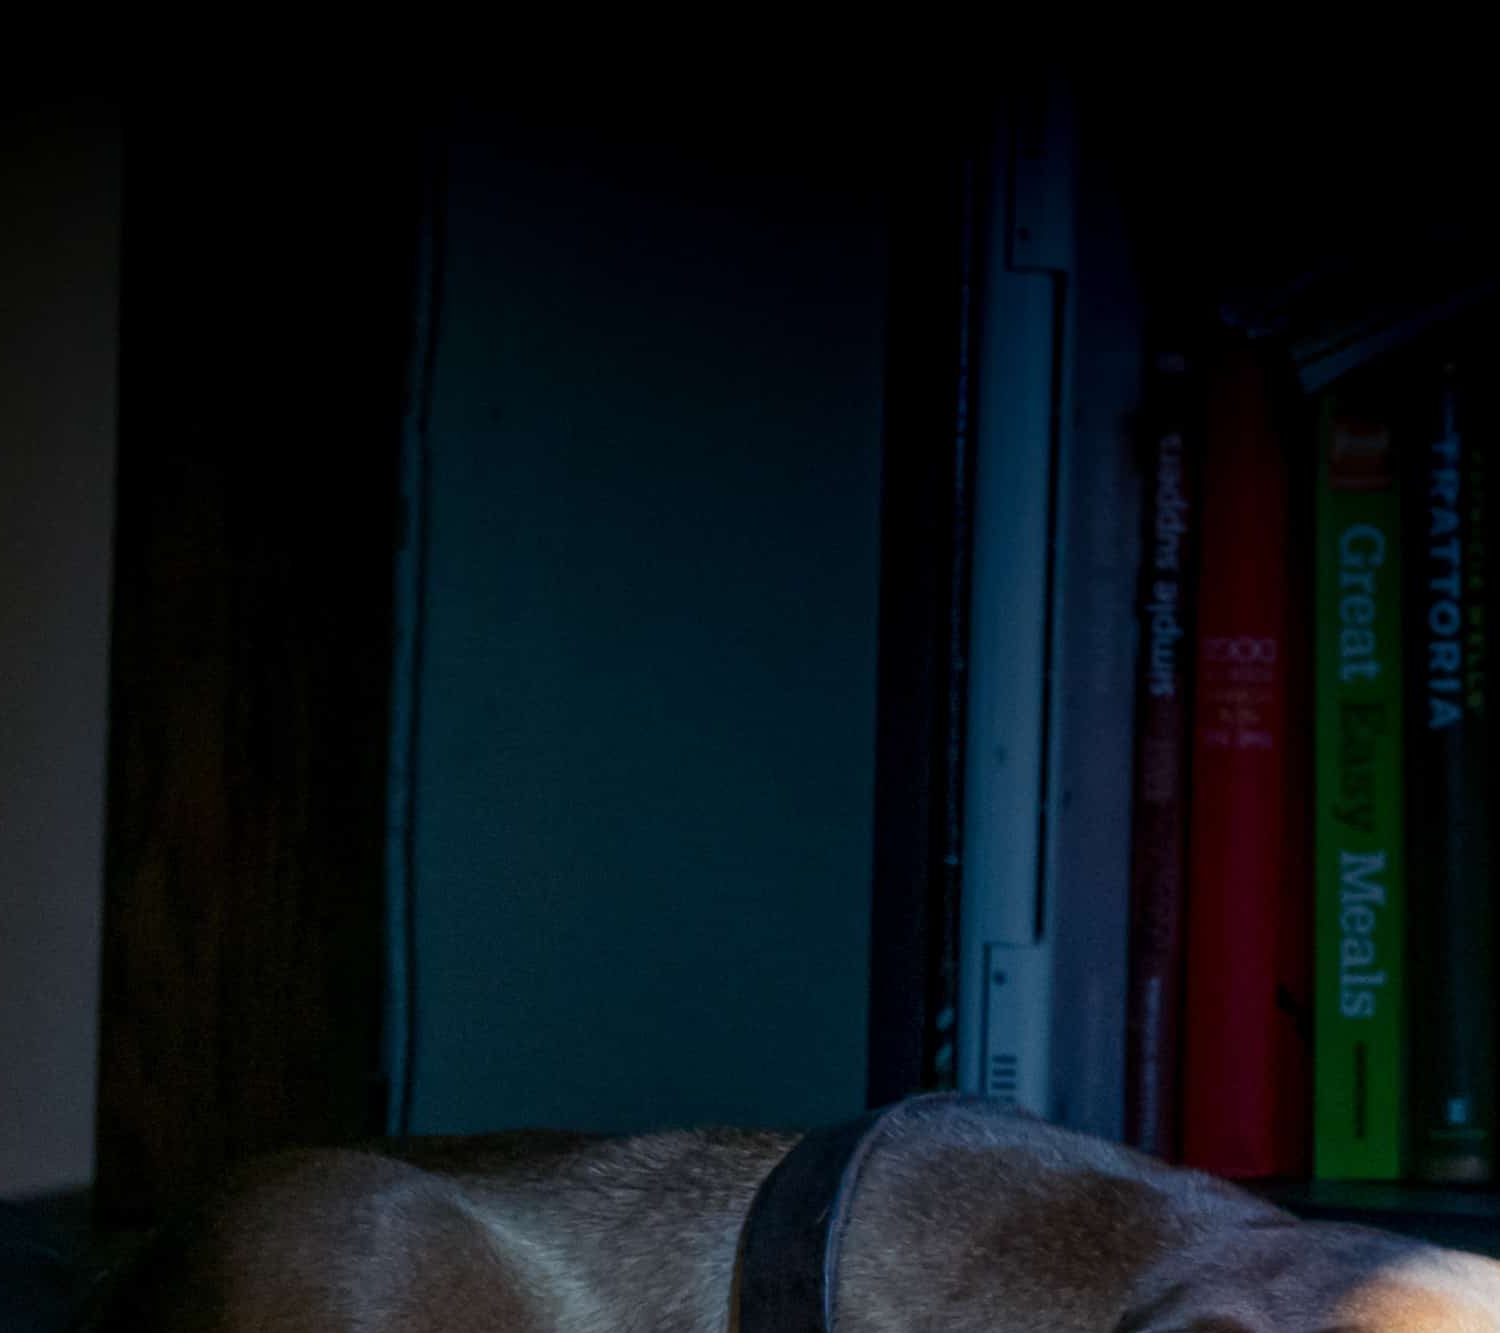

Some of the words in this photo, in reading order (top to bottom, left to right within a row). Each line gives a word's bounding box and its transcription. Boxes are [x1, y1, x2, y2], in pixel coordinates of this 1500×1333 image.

[1152, 431, 1187, 570] suppers
[1145, 574, 1182, 698] simple
[1338, 522, 1387, 681] Great
[1424, 430, 1463, 733] TRATTORIA
[1331, 698, 1384, 833] Easy
[1338, 850, 1388, 1020] Meals
